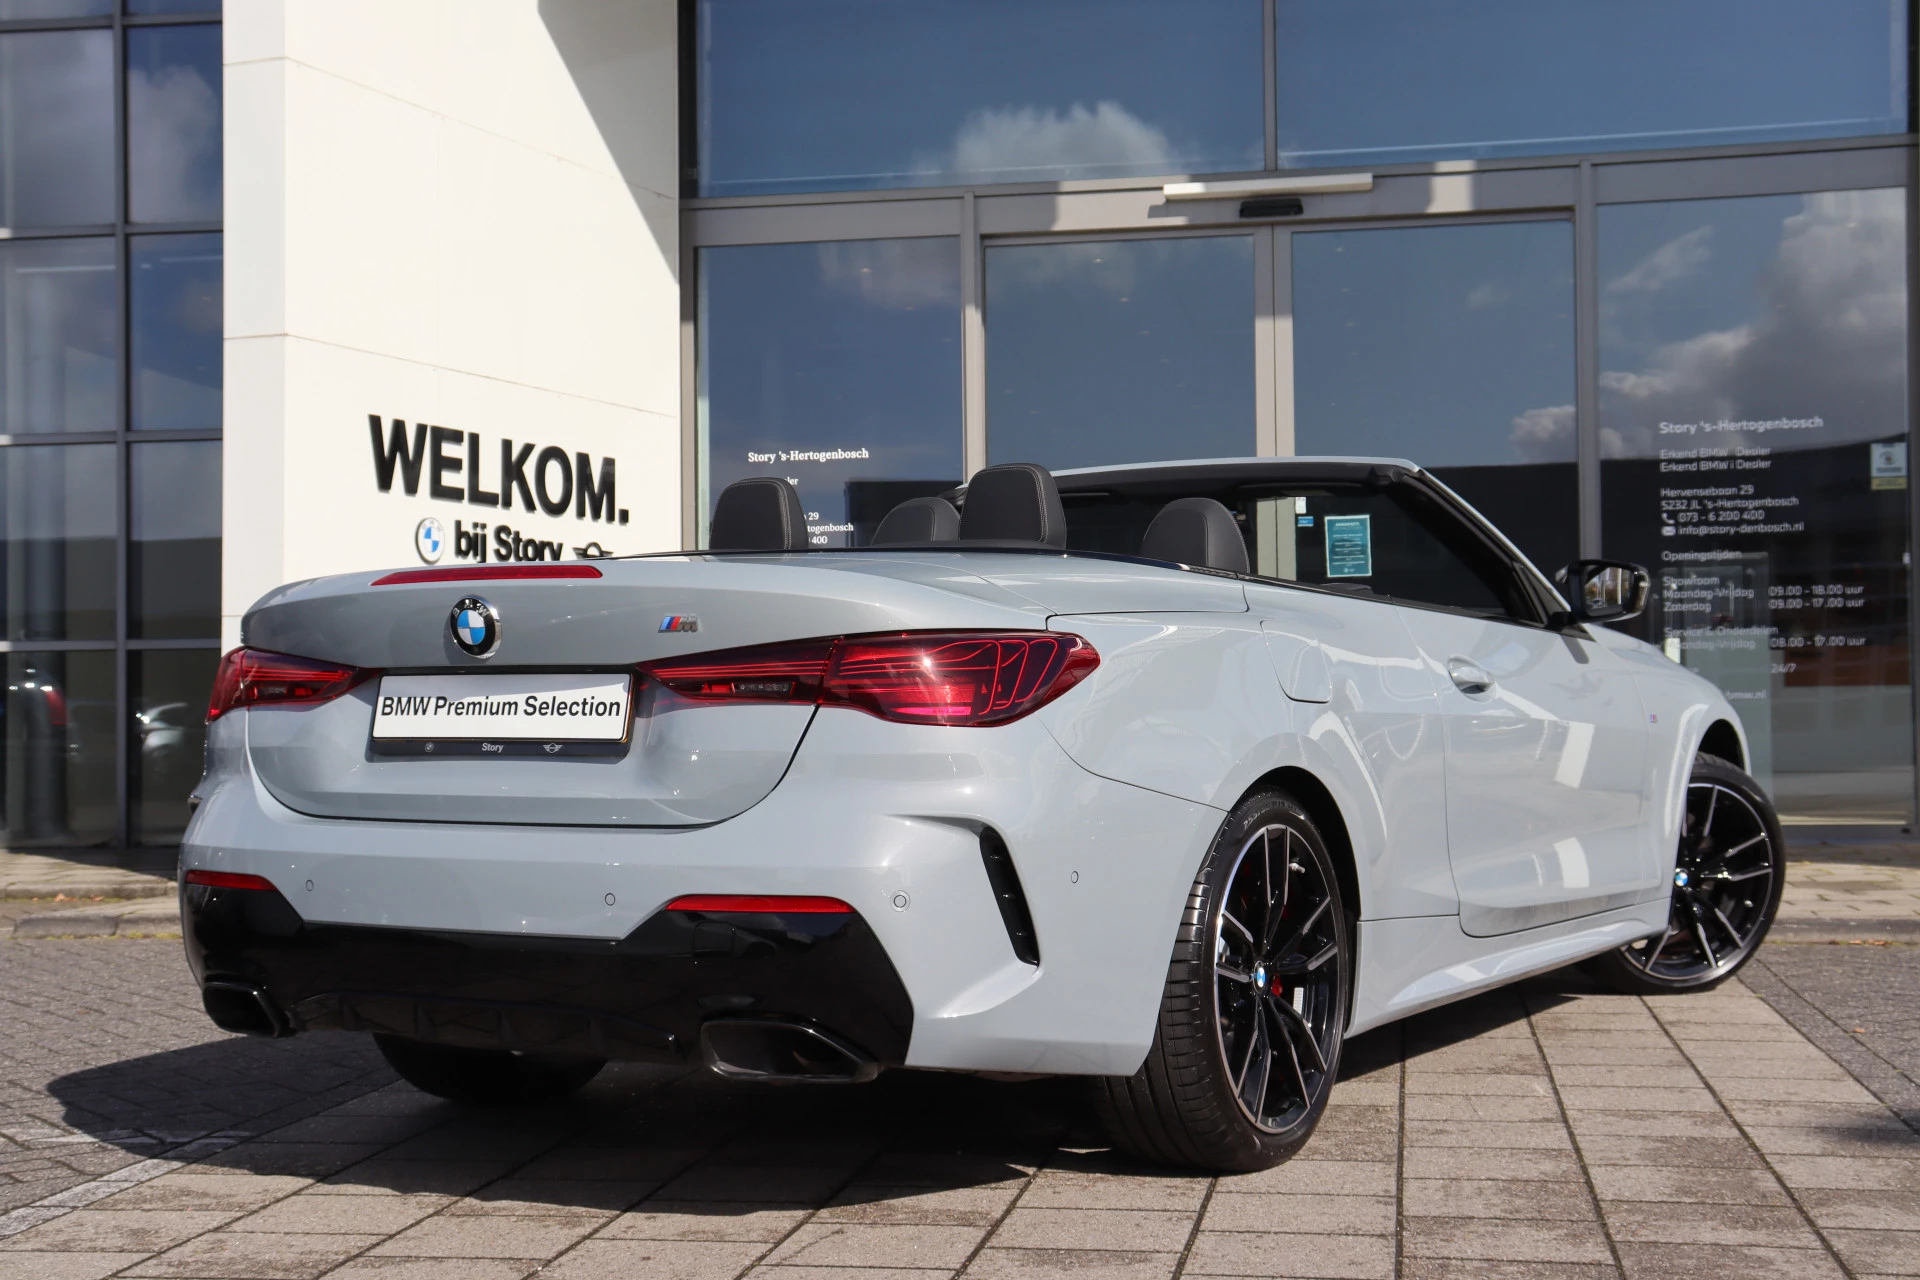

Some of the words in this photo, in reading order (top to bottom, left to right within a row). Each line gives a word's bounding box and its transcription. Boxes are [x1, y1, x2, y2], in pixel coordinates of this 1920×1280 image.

[1658, 421, 1698, 435] Story
[1700, 416, 1824, 433] 's-Hertogenbosch
[747, 451, 777, 464] Story
[1659, 449, 1698, 460] Erkend
[1700, 447, 1729, 458] BMW
[1735, 446, 1772, 457] Dealer
[367, 413, 630, 526] WELKOM.
[1659, 461, 1698, 472] Erkend
[1700, 460, 1729, 471] BMW
[1736, 459, 1772, 470] Dealer
[784, 476, 799, 486] ler
[1740, 485, 1755, 495] 29
[1661, 500, 1688, 511] 5232
[808, 511, 820, 521] 29
[1677, 512, 1699, 522] 073
[1707, 511, 1717, 521] 6
[1718, 510, 1741, 521] 200
[1742, 509, 1765, 520] 400
[455, 519, 487, 563] bij
[811, 535, 828, 544] 400
[1661, 550, 1743, 562] Openingstijden
[1663, 576, 1720, 587] Showroom
[1767, 585, 1803, 596] 09.00
[1811, 584, 1844, 595] 18.00
[1845, 585, 1865, 595] uur
[1663, 602, 1712, 613] Zaterdag
[1768, 598, 1803, 609] 09.00
[1845, 598, 1866, 608] uur
[1769, 637, 1805, 648] 08.00
[381, 696, 432, 716] BMW
[434, 695, 518, 716] Premium
[524, 695, 621, 717] Selection
[482, 742, 504, 753] Story
